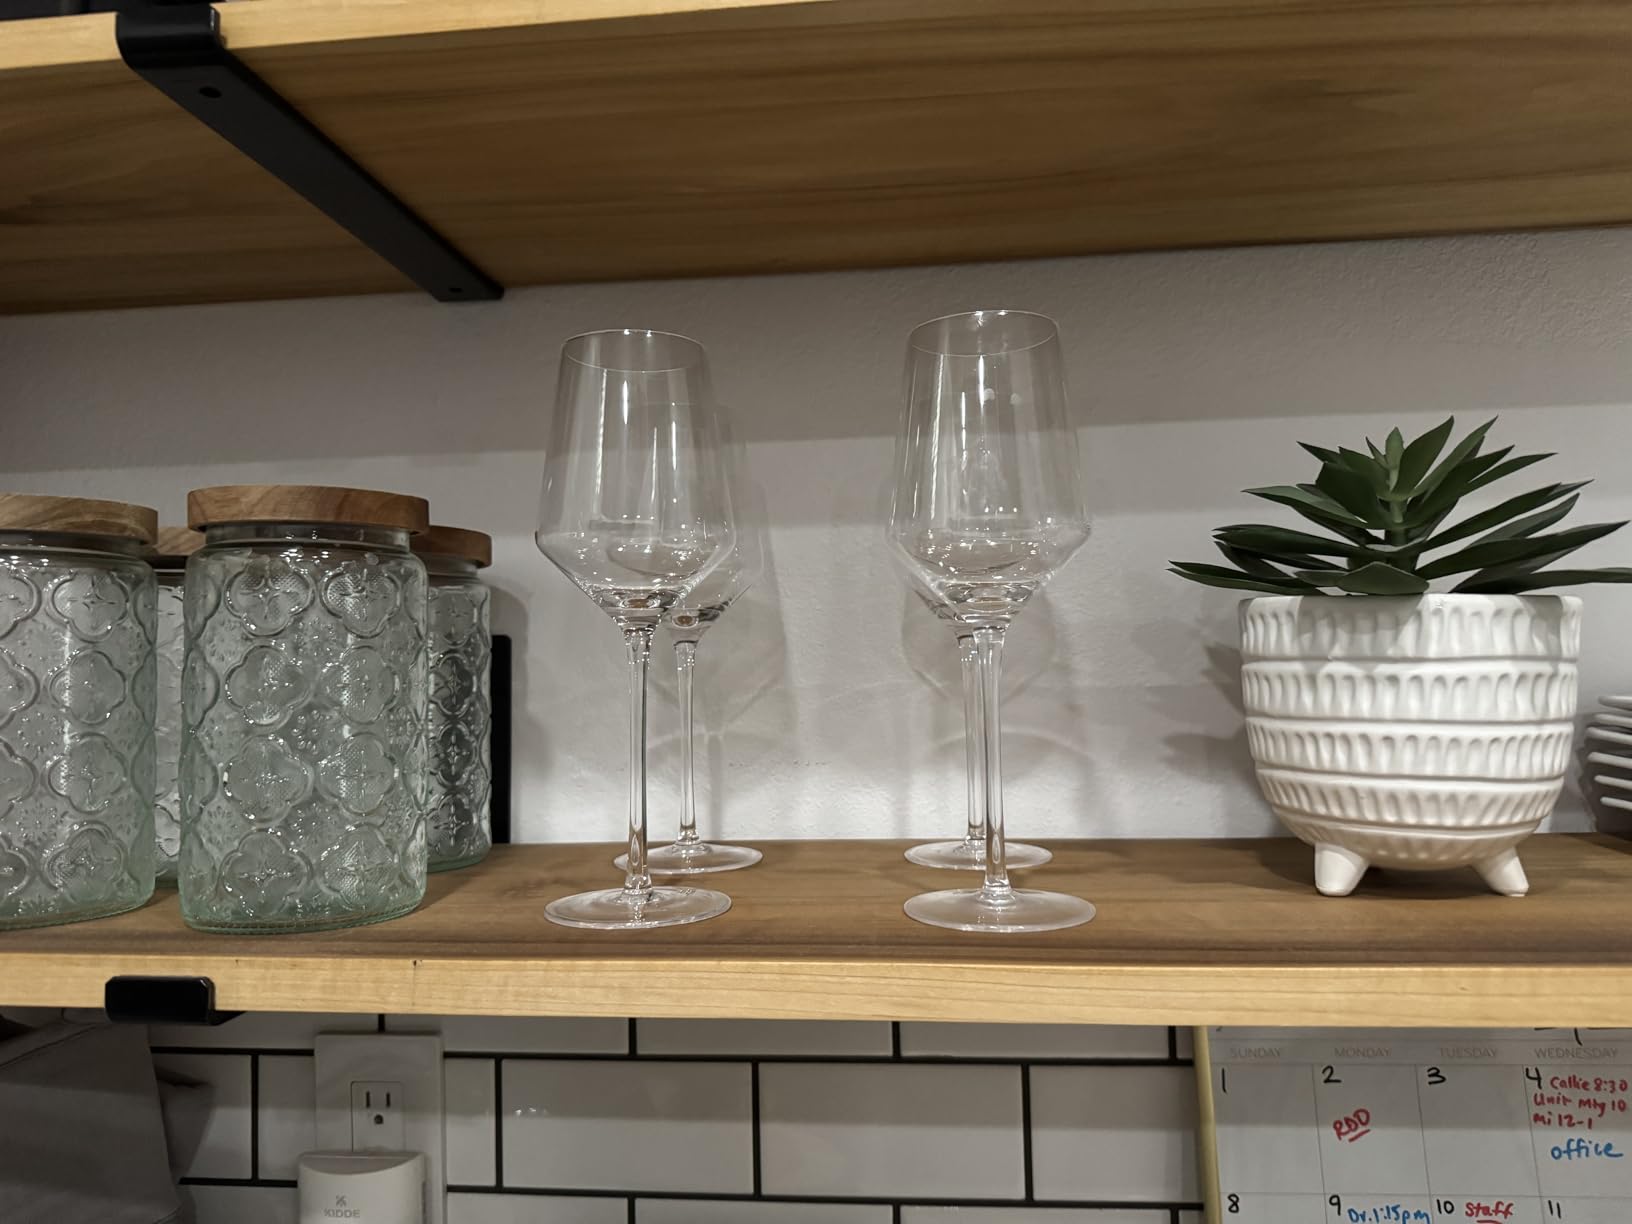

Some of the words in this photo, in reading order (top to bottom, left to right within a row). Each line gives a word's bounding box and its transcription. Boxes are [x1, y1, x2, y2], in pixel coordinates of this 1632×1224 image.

[1230, 1047, 1282, 1058] SUNDAY
[1334, 1047, 1392, 1058] MONDAY
[1439, 1047, 1498, 1058] TUESDAY
[1534, 1047, 1618, 1059] WEDNESDAY
[1221, 1067, 1228, 1094] 1
[1321, 1064, 1343, 1084] 2
[1426, 1066, 1447, 1086] 3
[1525, 1066, 1543, 1090] 4
[1593, 1077, 1628, 1093] 8:30
[1611, 1099, 1627, 1113] 10
[1557, 1112, 1593, 1130] 12-1
[1226, 1193, 1240, 1214] 8
[1328, 1194, 1342, 1217] 9
[1436, 1198, 1455, 1215] 10
[1464, 1200, 1514, 1220] Staff
[1547, 1199, 1562, 1219] 11
[323, 1208, 361, 1218] KIDDE
